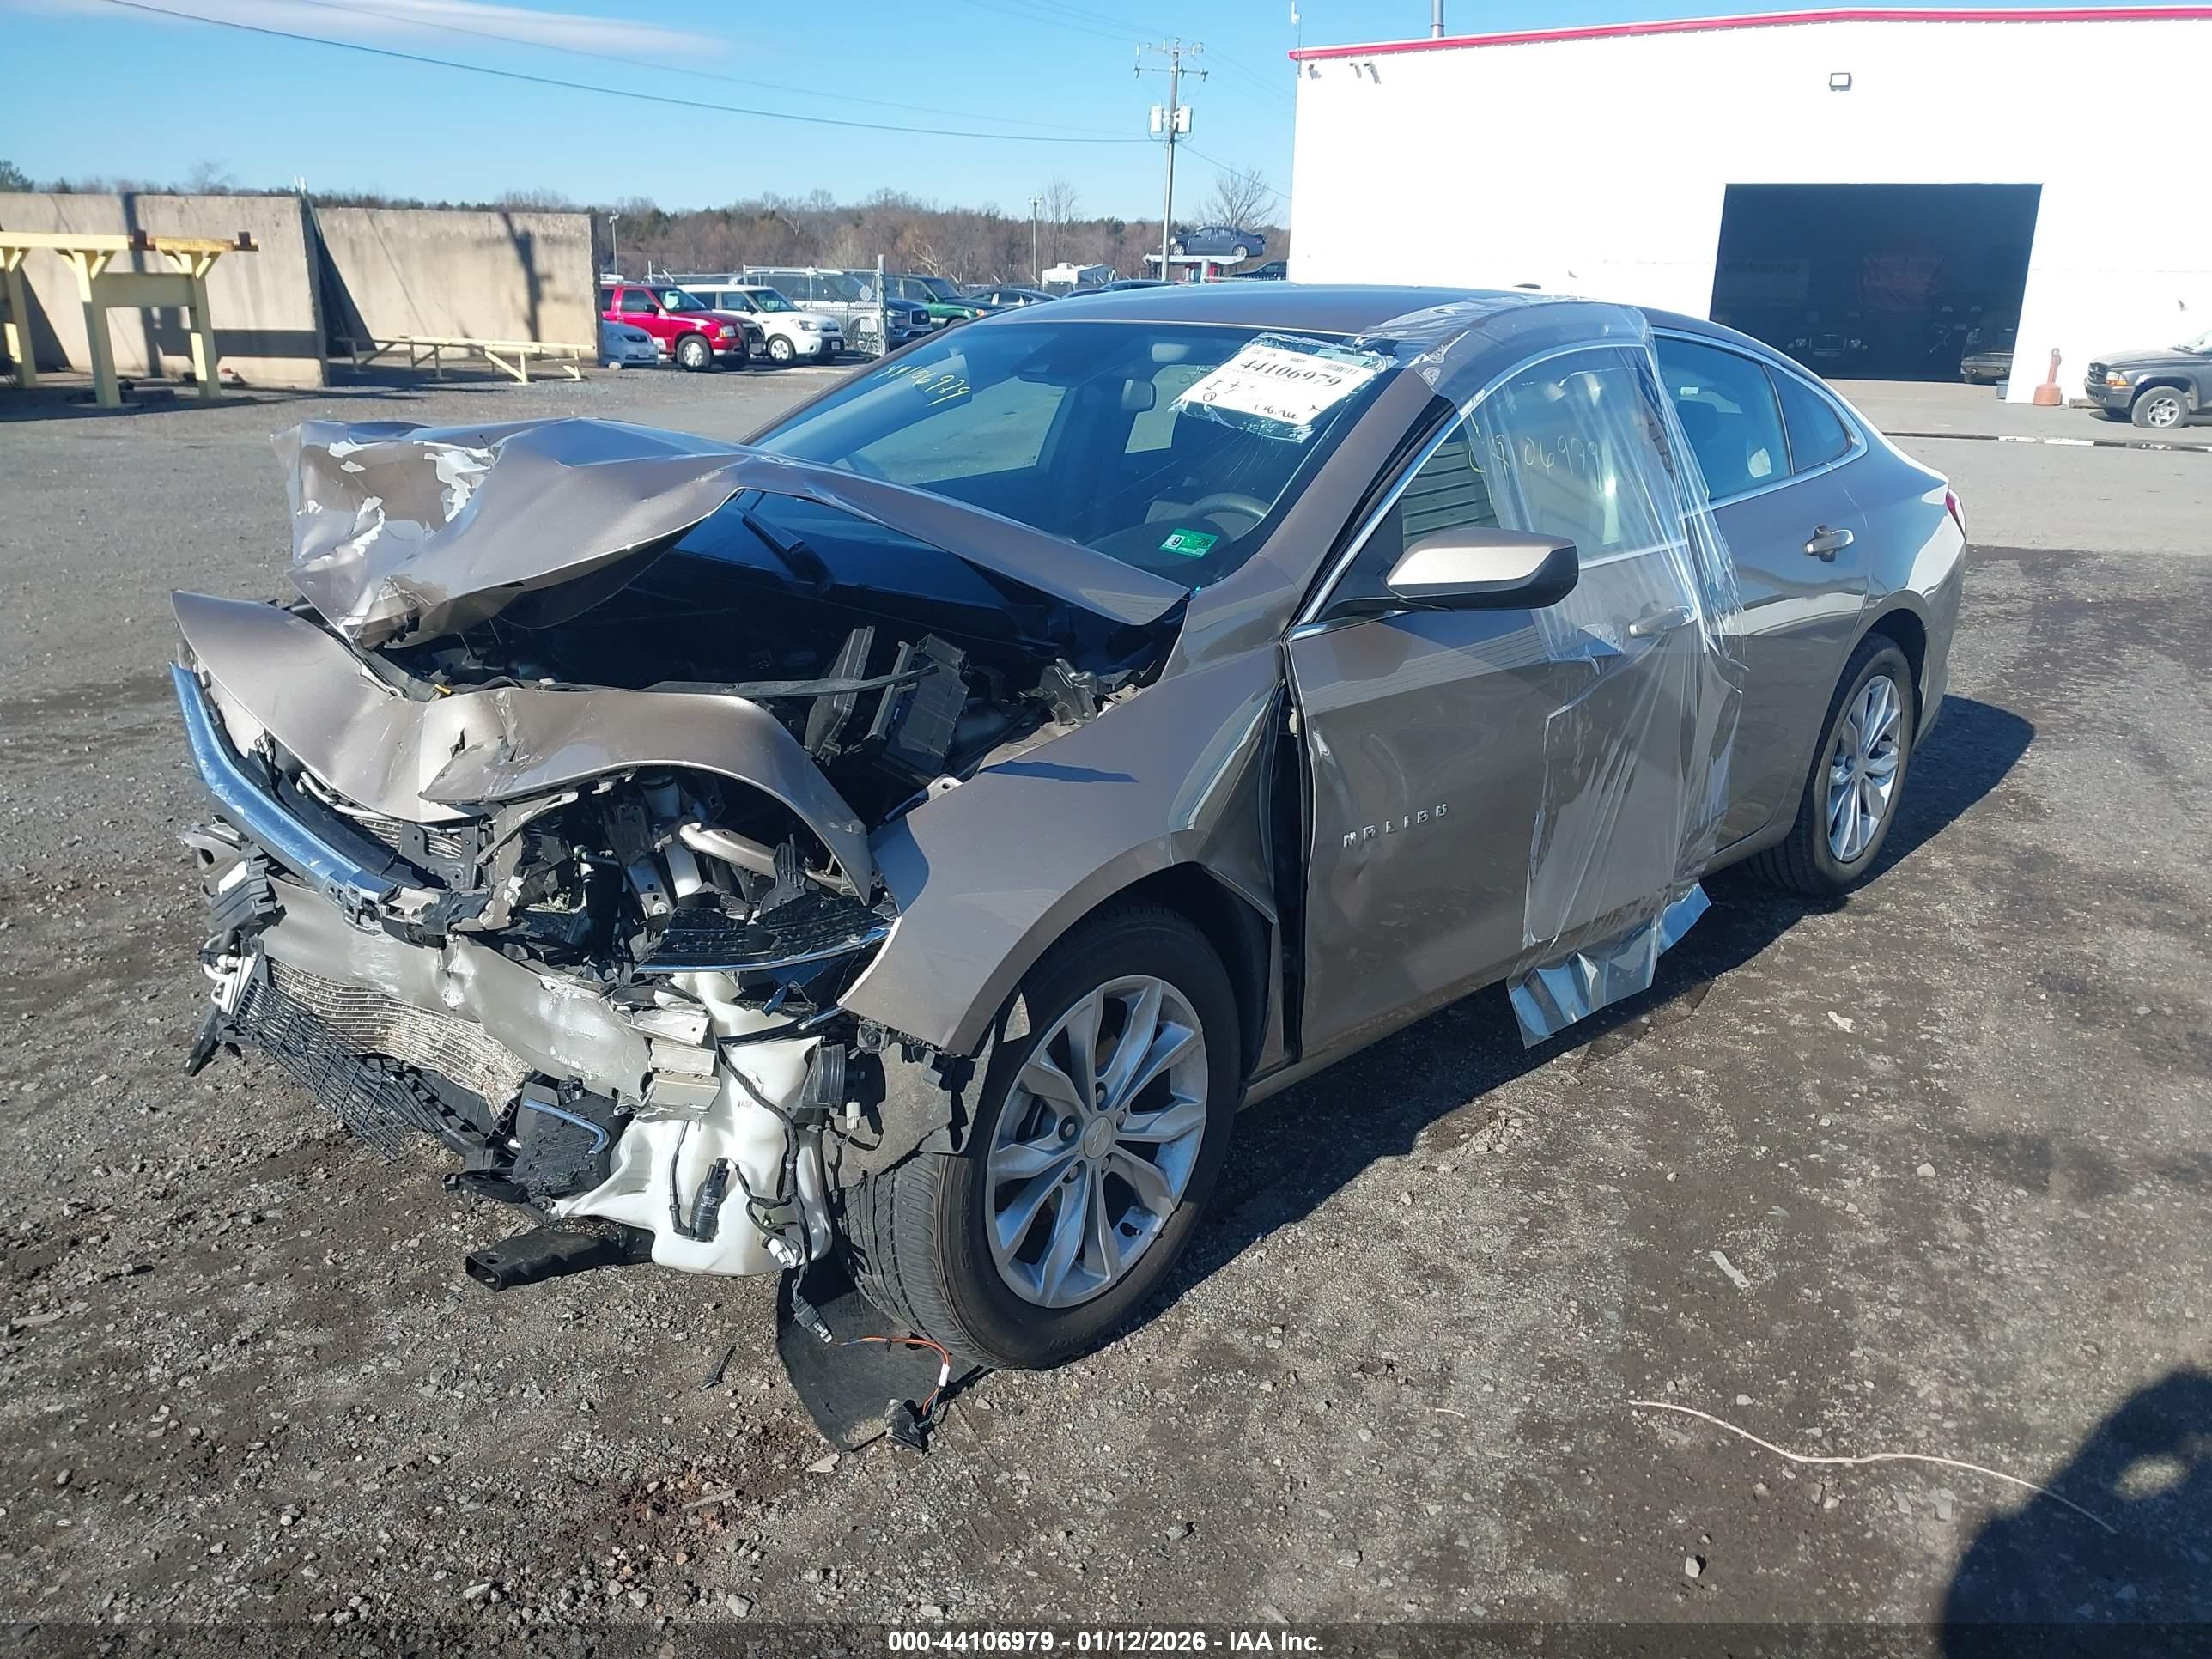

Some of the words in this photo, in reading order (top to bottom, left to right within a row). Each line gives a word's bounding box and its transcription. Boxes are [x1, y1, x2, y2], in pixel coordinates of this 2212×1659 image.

[1240, 359, 1342, 386] 44106979
[1171, 537, 1182, 546] 9
[1342, 803, 1448, 848] MALIBU
